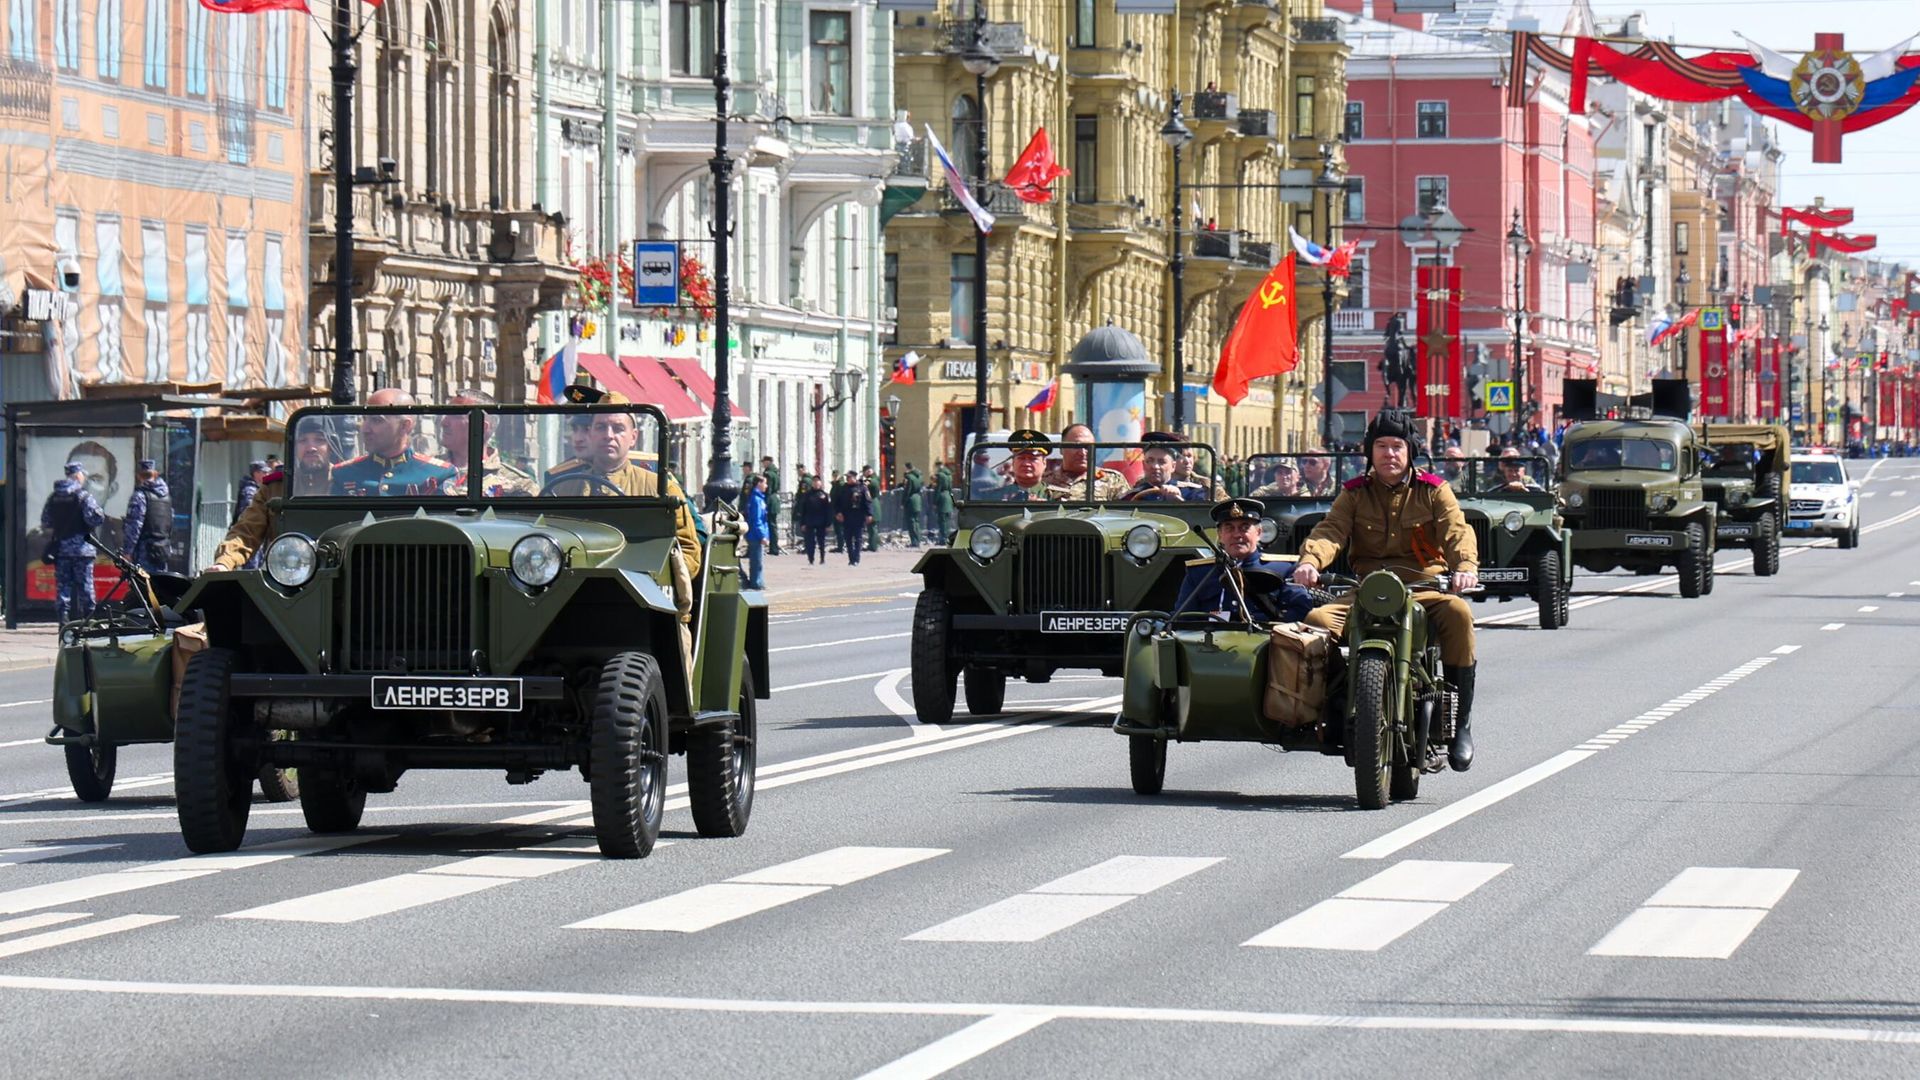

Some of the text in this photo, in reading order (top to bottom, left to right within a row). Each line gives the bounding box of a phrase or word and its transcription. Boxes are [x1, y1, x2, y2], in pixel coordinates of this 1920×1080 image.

[946, 361, 993, 378] ПЕКАЯ
[1424, 384, 1450, 396] 1945
[1479, 571, 1524, 580] ЕНРЕЗЕРВ
[1048, 617, 1129, 631] ЛЕНРЕЗЕРВ
[384, 686, 510, 707] ЛЕНРЕЗЕРВ
